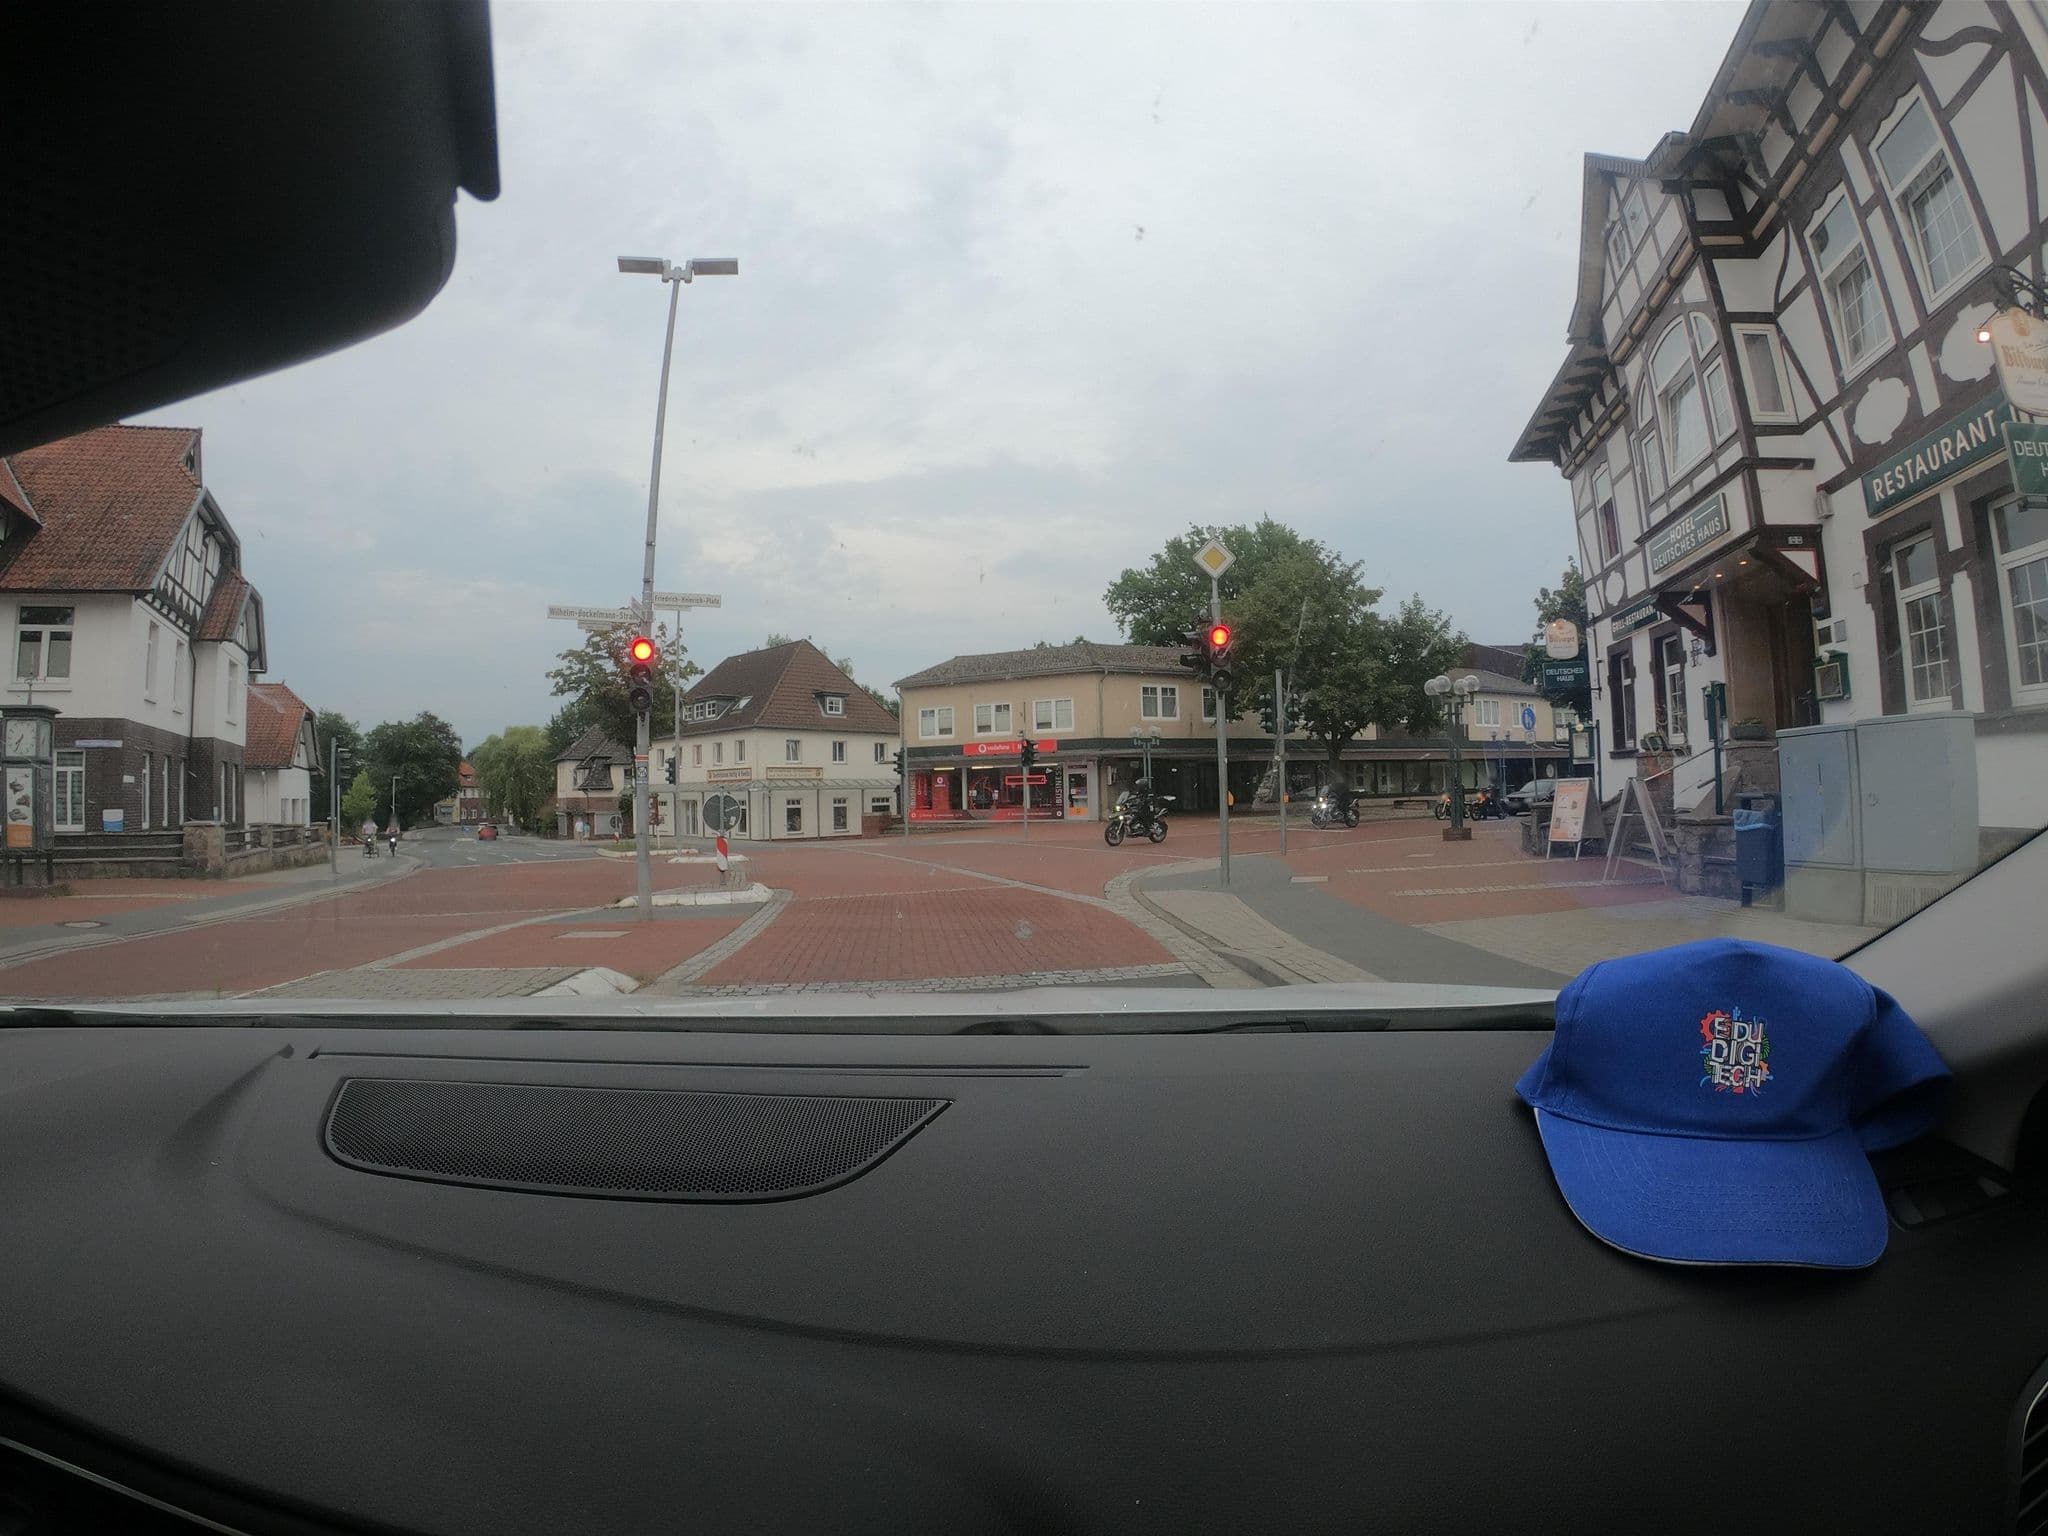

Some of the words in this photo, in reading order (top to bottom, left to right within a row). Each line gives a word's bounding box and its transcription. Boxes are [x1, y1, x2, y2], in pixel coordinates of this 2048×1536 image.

[1872, 409, 1997, 502] RESTAURANT
[1669, 516, 1696, 542] HOTEL
[1653, 535, 1697, 571] DEUTSCHES
[1697, 516, 1721, 544] HAUS
[1545, 667, 1584, 676] DEUTSCHES
[1714, 1017, 1764, 1043] EDU
[1711, 1039, 1761, 1067] DIGI
[1710, 1061, 1761, 1088] TECH
